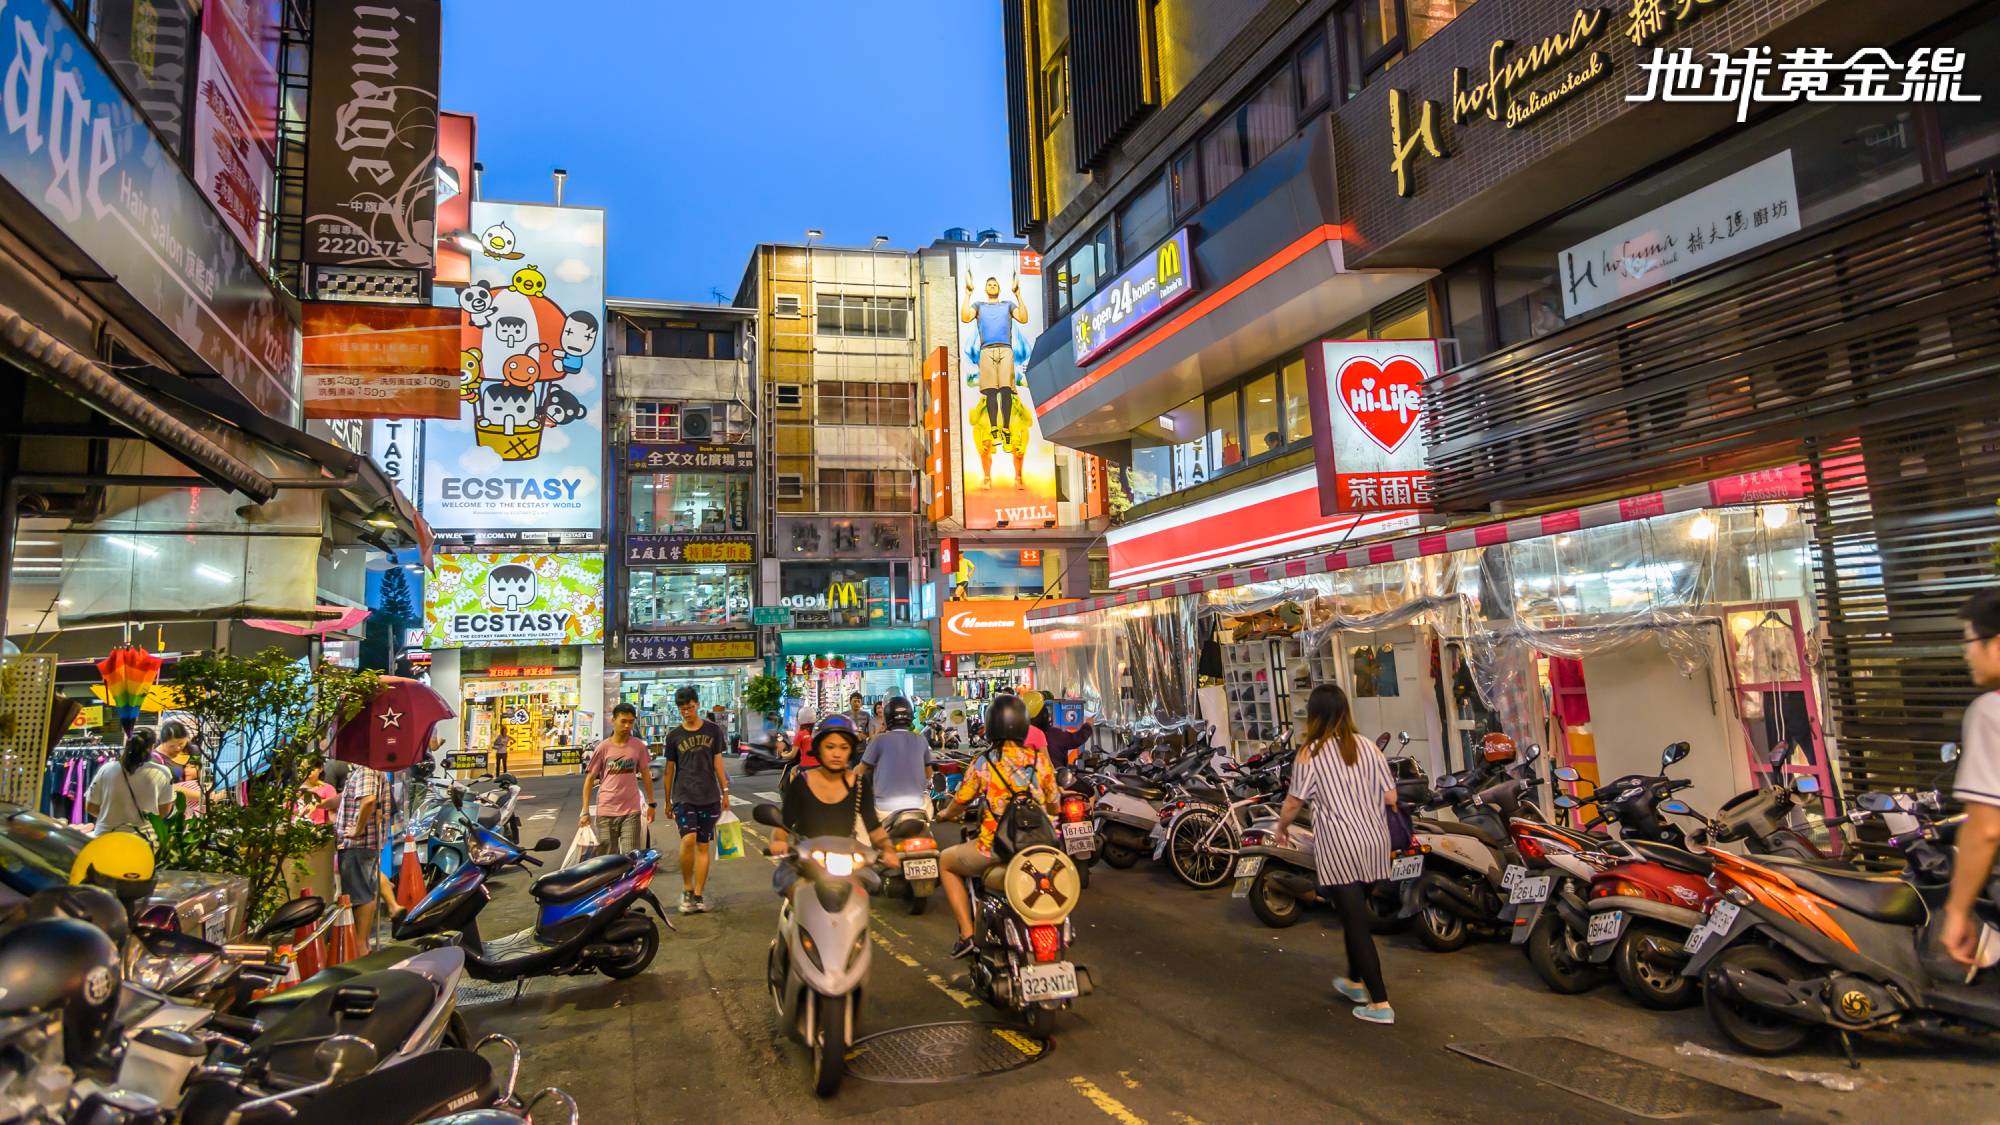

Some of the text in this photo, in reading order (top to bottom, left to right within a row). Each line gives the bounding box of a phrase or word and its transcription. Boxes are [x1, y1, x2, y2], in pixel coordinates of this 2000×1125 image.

[1559, 51, 1604, 95] steak
[335, 5, 415, 186] image
[119, 170, 184, 269] Hair Salon
[1092, 277, 1157, 331] open 24 hours
[1350, 378, 1422, 424] Hi-Life
[648, 451, 735, 466] 全文文化廣場
[441, 477, 581, 500] ECSTASY
[995, 508, 1004, 522] I
[454, 613, 568, 633] ECSTASY
[1024, 977, 1076, 995] 323-NTH
[447, 1090, 479, 1112] YAMAHA
